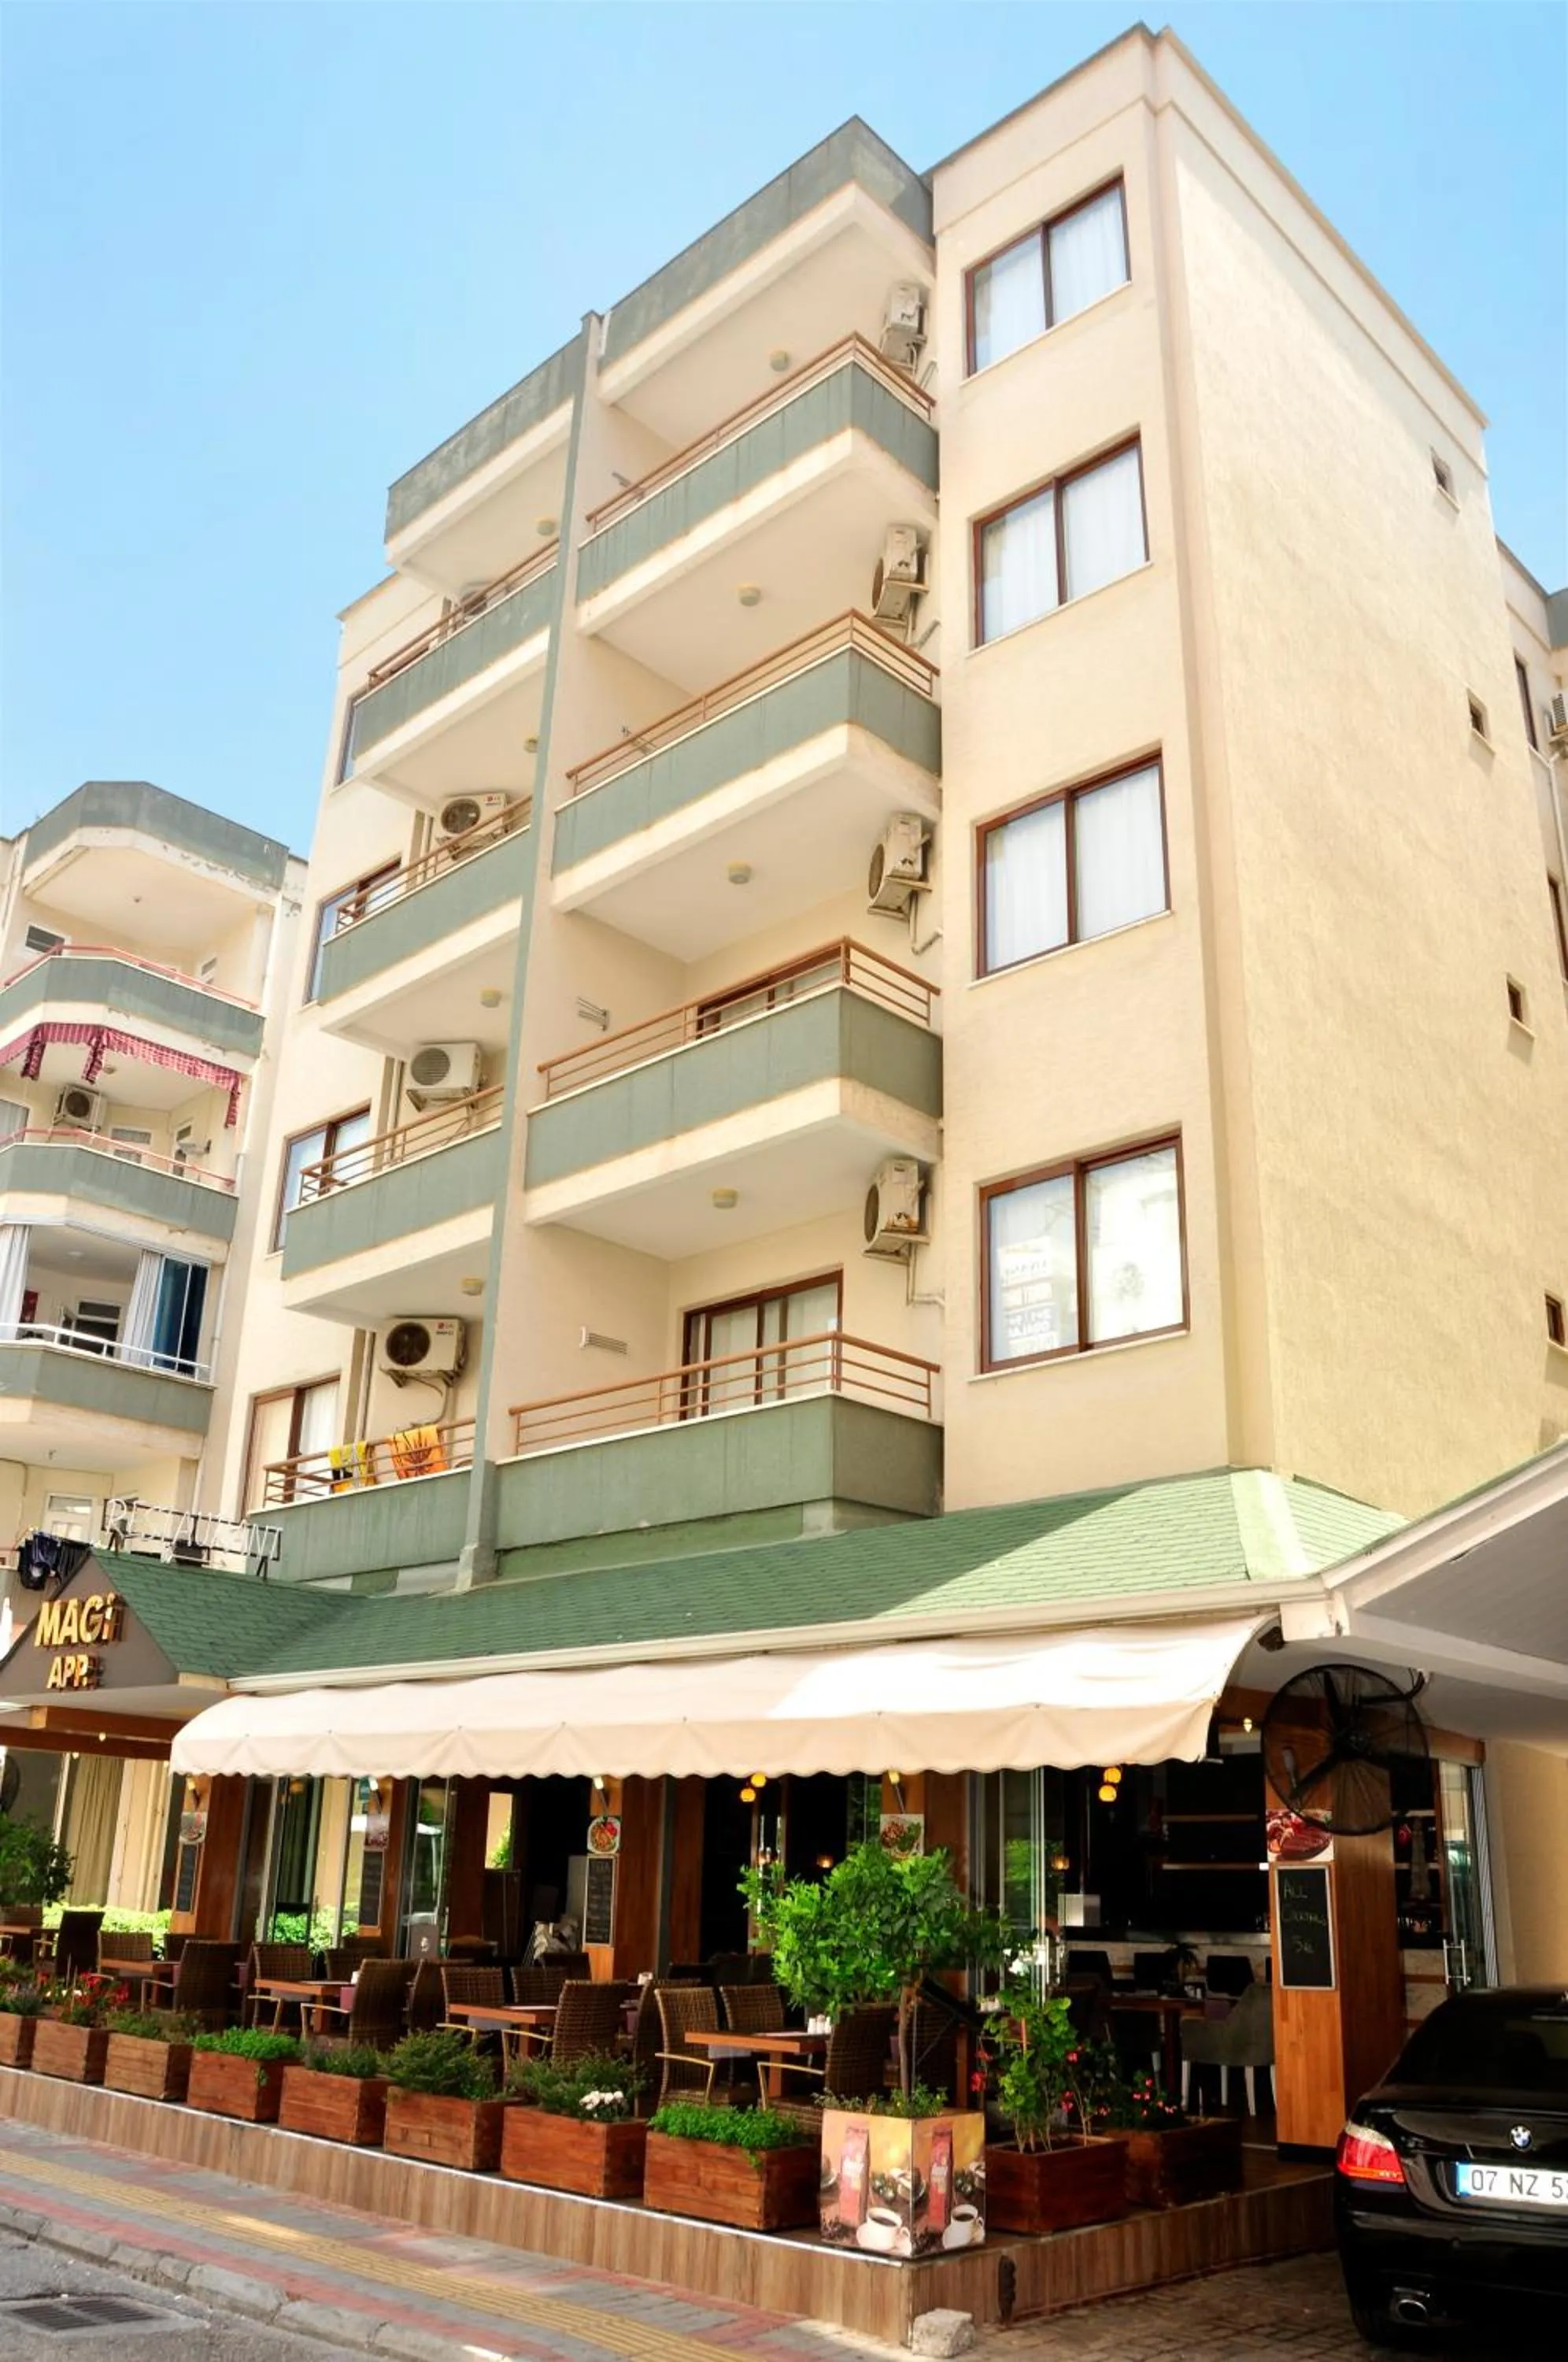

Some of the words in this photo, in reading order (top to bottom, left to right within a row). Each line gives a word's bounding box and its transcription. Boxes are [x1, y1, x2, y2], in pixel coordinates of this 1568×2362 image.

[1471, 2170, 1498, 2192] 07
[1510, 2173, 1539, 2197] NZ
[1551, 2177, 1568, 2199] 5
